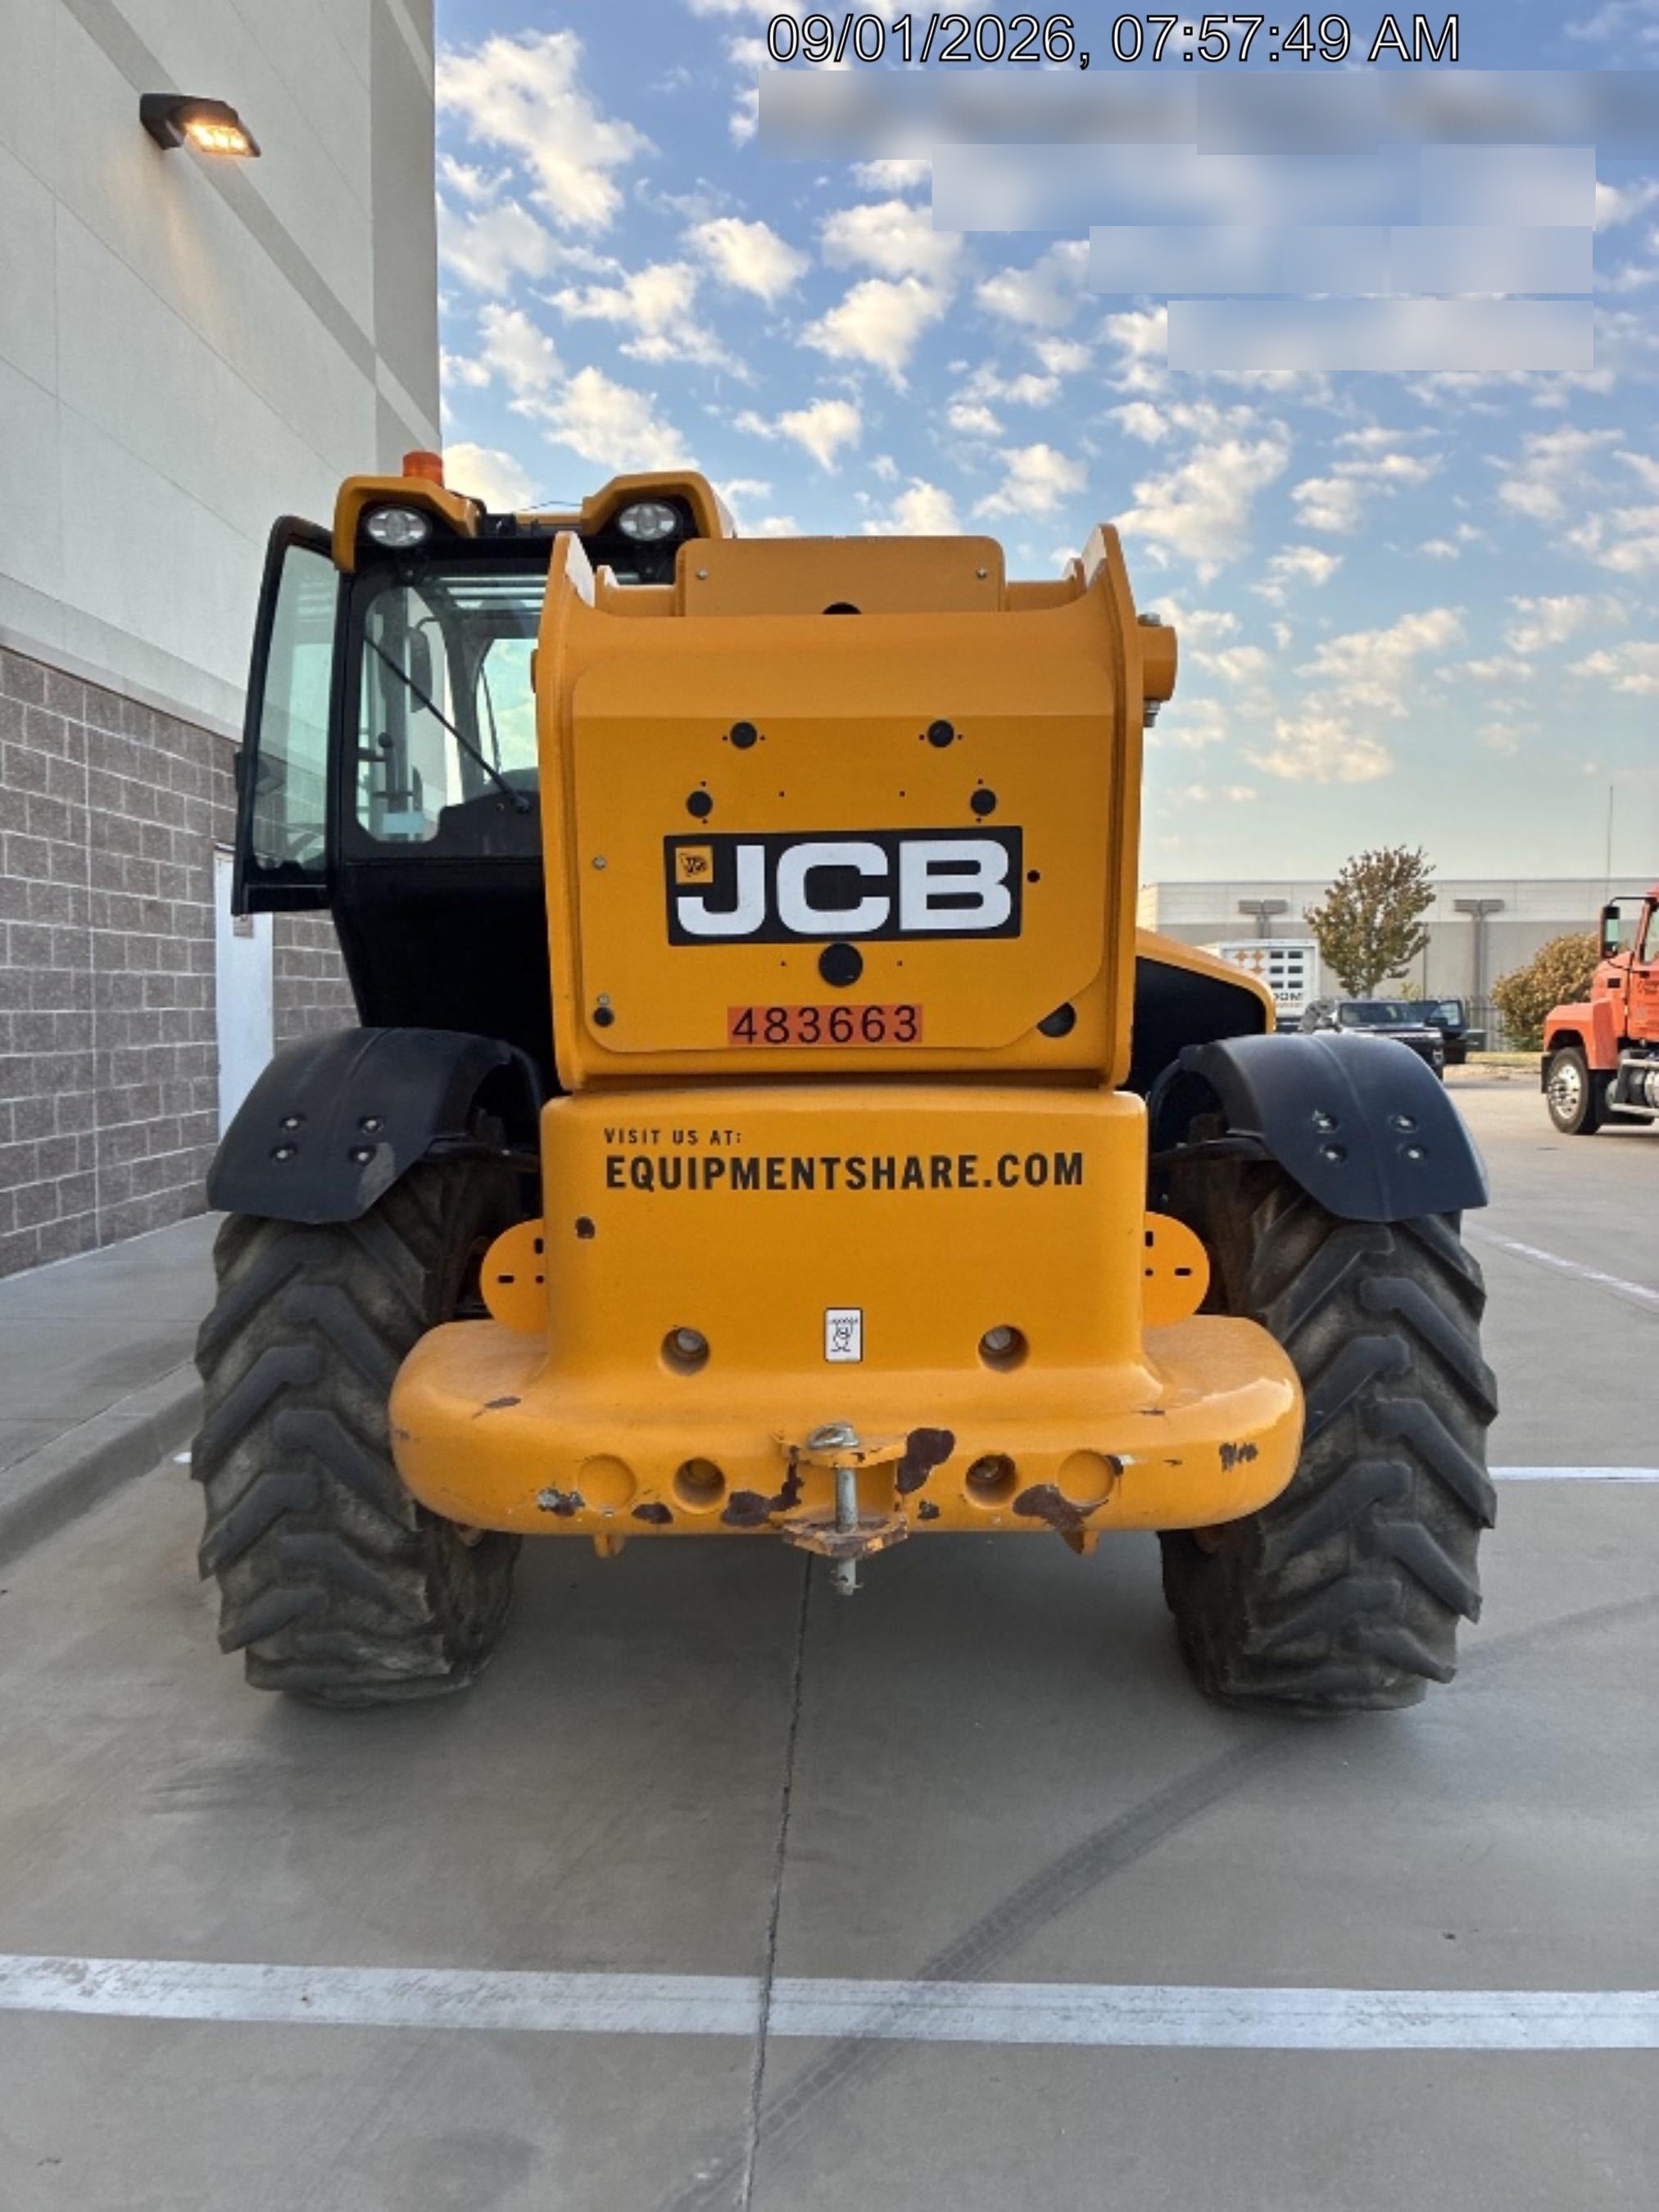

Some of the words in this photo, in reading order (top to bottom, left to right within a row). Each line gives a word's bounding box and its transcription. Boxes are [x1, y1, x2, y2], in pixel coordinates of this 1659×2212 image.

[677, 841, 1011, 935] JCB
[732, 1005, 918, 1045] 483663
[604, 1127, 660, 1145] VISIT
[672, 1129, 699, 1146] US
[709, 1130, 741, 1146] AT:
[606, 1152, 1082, 1193] EQUIPMENTSHARE.COM
